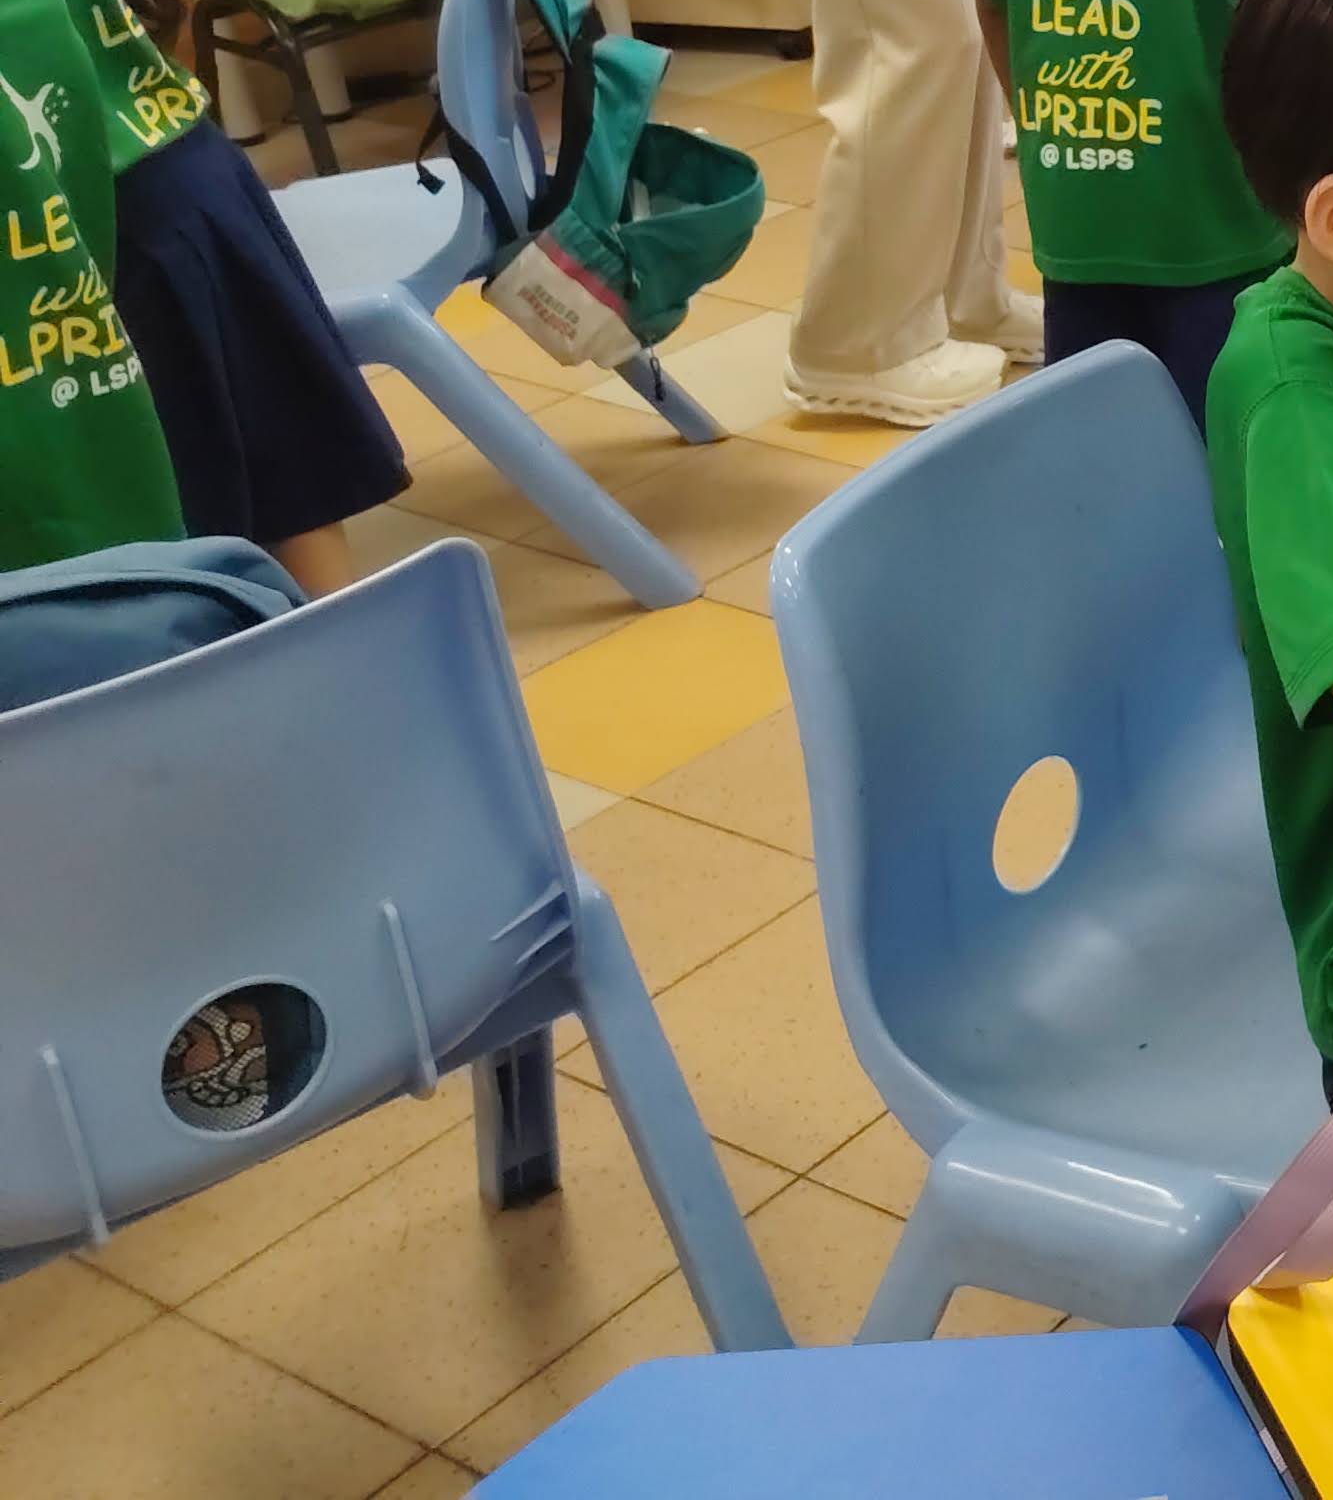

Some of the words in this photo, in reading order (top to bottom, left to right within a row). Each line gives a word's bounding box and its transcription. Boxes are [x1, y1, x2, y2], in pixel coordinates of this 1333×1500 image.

[92, 4, 145, 48] LE
[1037, 46, 1136, 90] with
[1040, 143, 1060, 168] @
[1065, 147, 1135, 171] LSPS
[8, 195, 76, 260] LE
[0, 304, 126, 386] LPRI
[51, 376, 79, 408] @
[90, 355, 143, 396] LSP
